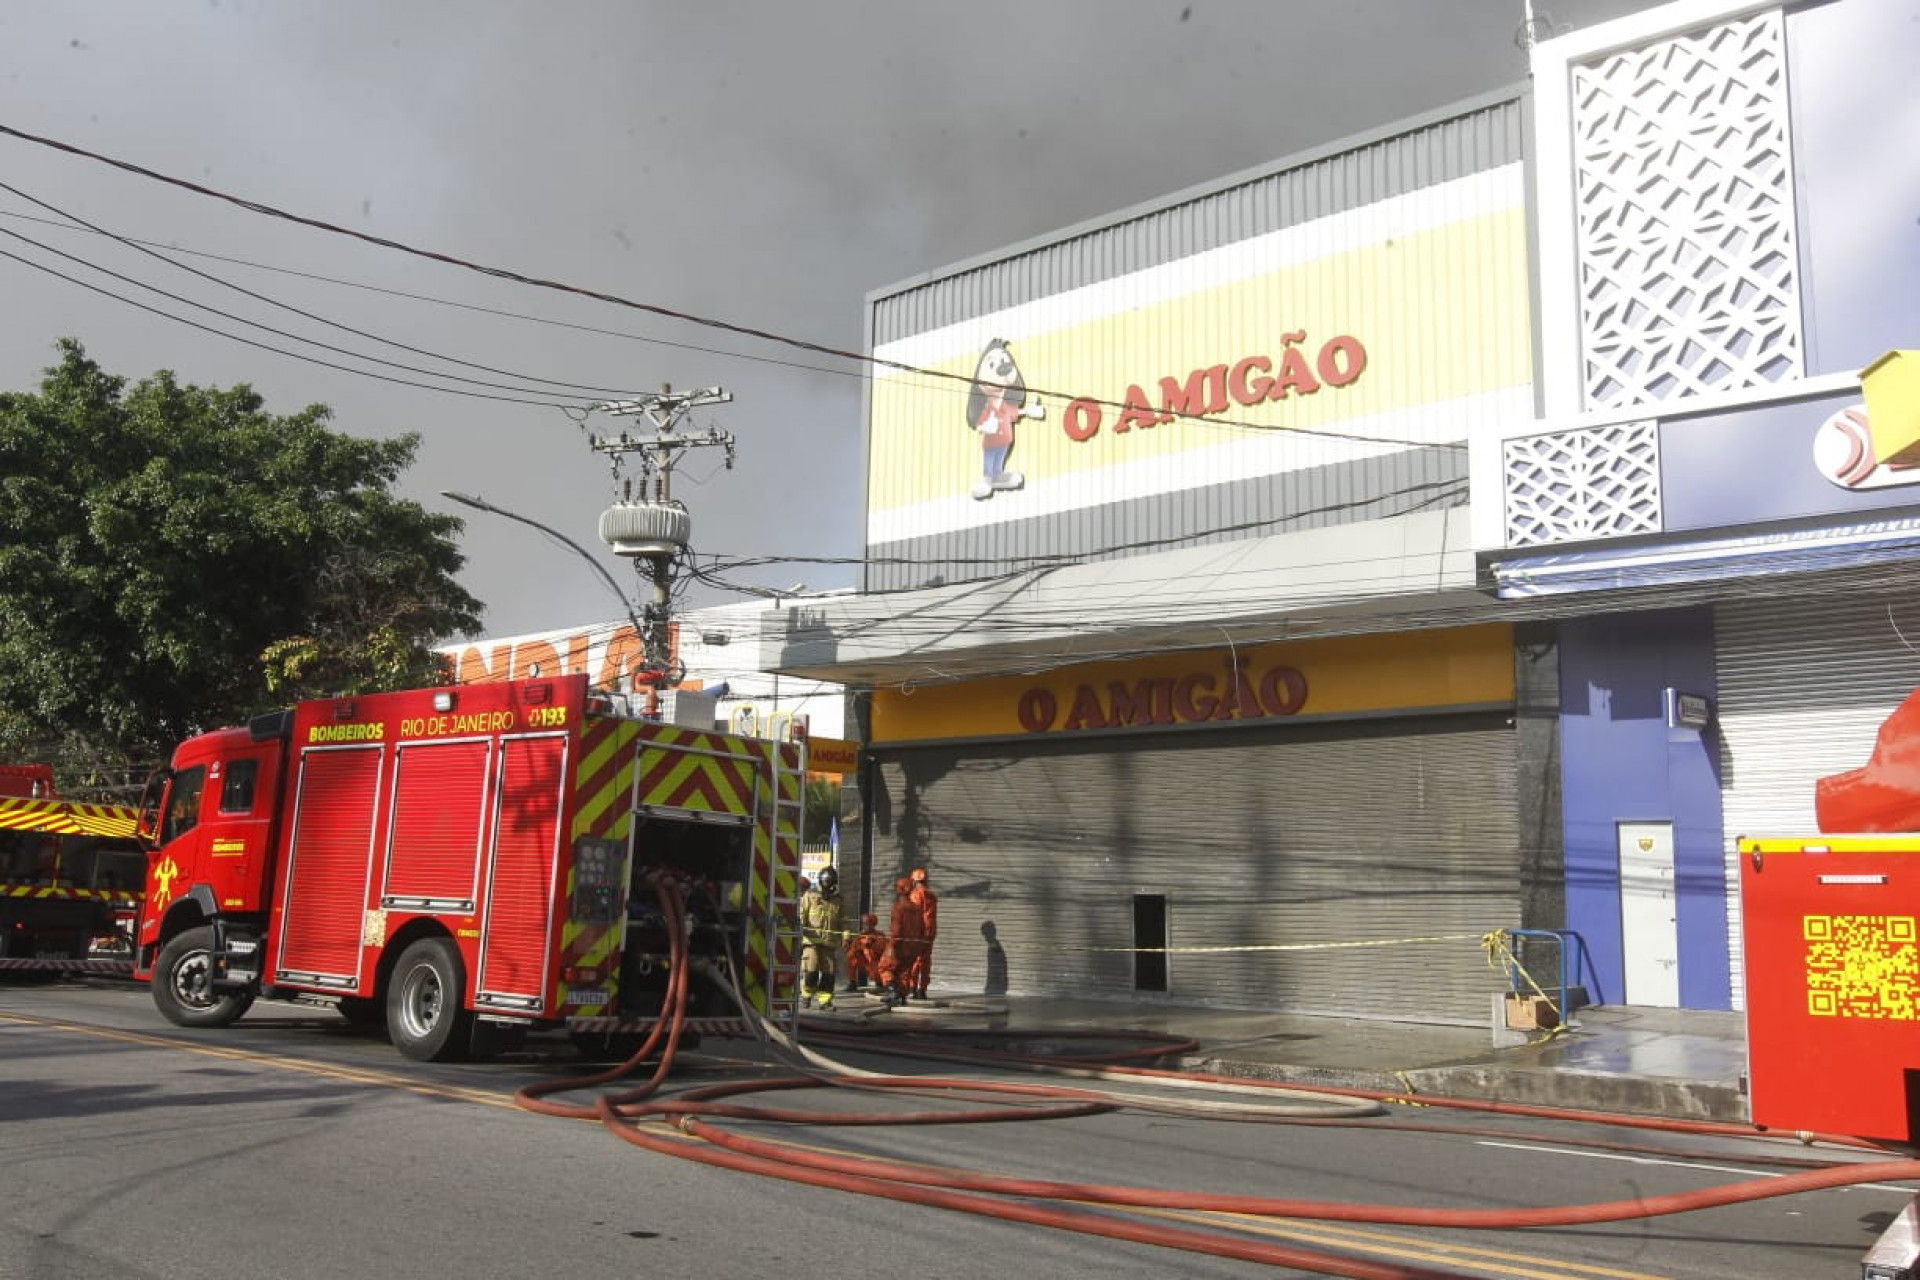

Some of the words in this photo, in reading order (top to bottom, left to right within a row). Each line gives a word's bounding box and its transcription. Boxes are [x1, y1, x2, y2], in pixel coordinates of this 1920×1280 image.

[1063, 397, 1102, 442] O
[1113, 329, 1368, 434] AMIGÃO
[1017, 687, 1057, 733] O
[1064, 655, 1308, 729] AMIGÃO
[401, 718, 425, 737] RIO
[427, 716, 448, 735] DE
[449, 711, 514, 734] JANEIRO
[541, 706, 566, 726] 193
[309, 722, 384, 742] BOMBEIROS
